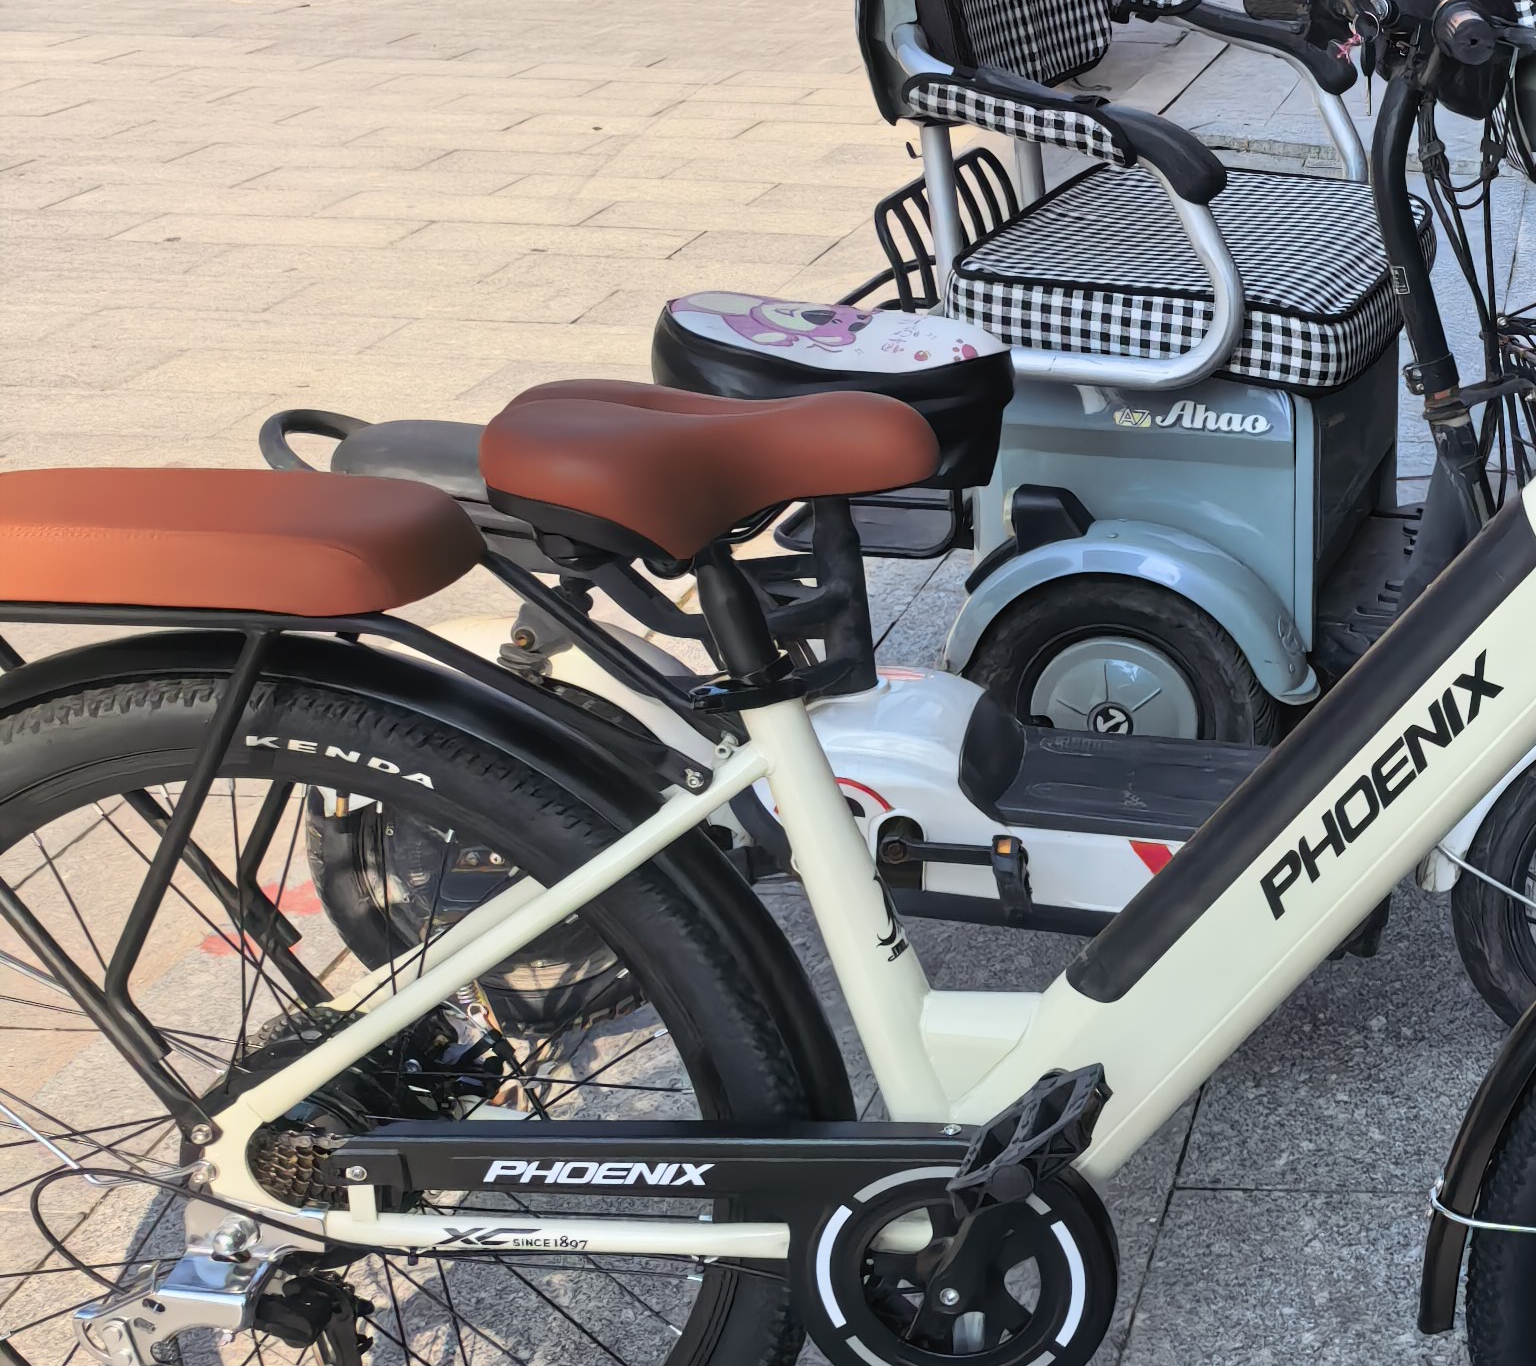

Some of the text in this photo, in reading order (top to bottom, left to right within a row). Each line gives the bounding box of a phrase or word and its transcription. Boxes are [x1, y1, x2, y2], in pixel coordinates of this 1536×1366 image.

[1155, 400, 1273, 434] Ahao
[245, 735, 435, 790] KENDA
[1259, 648, 1505, 921] PHOENIX
[482, 1160, 715, 1186] PHOENIX
[553, 1235, 589, 1251] 1897
